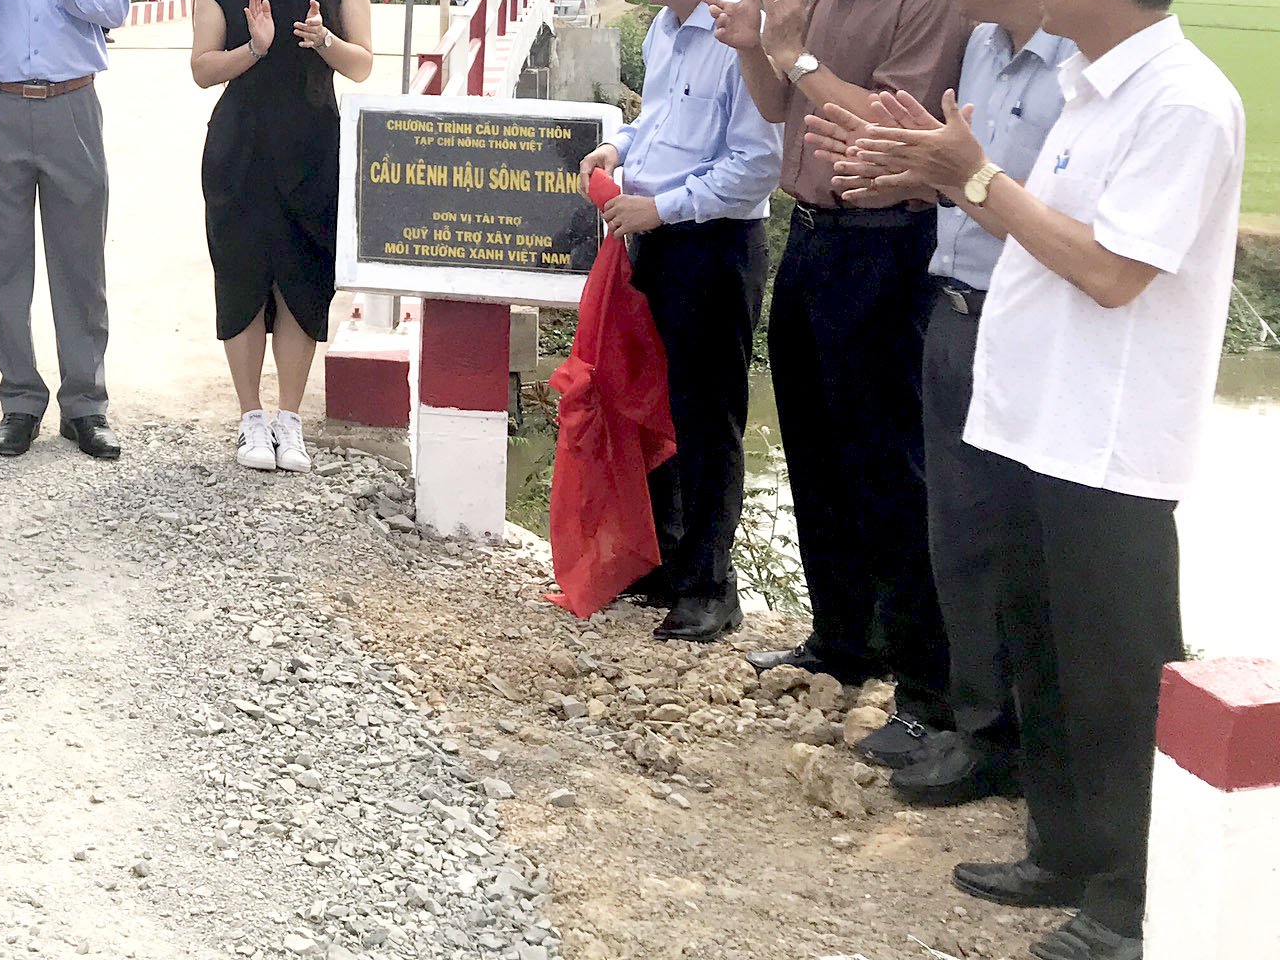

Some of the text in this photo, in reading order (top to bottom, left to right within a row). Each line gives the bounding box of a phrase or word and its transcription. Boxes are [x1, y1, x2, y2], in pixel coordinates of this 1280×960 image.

[386, 120, 435, 134] CHƯƠNG
[437, 121, 473, 135] TRÌNH
[503, 124, 536, 139] NÔNG
[538, 126, 572, 140] THÔN
[414, 135, 542, 152] TẠP CHÍ NÔNG THÔN VIỆT
[369, 154, 402, 185] CẦU
[405, 160, 449, 187] KÊNH
[452, 161, 485, 192] HẬU
[488, 163, 531, 192] SÔNG
[431, 211, 523, 226] ĐƠN VỊ TÀI TRỢ
[402, 225, 553, 249] QUỸ HỖ TRỢ XÂY DỰNG
[384, 242, 571, 265] MÔI TRƯỜNG XANH VIỆT NAM
